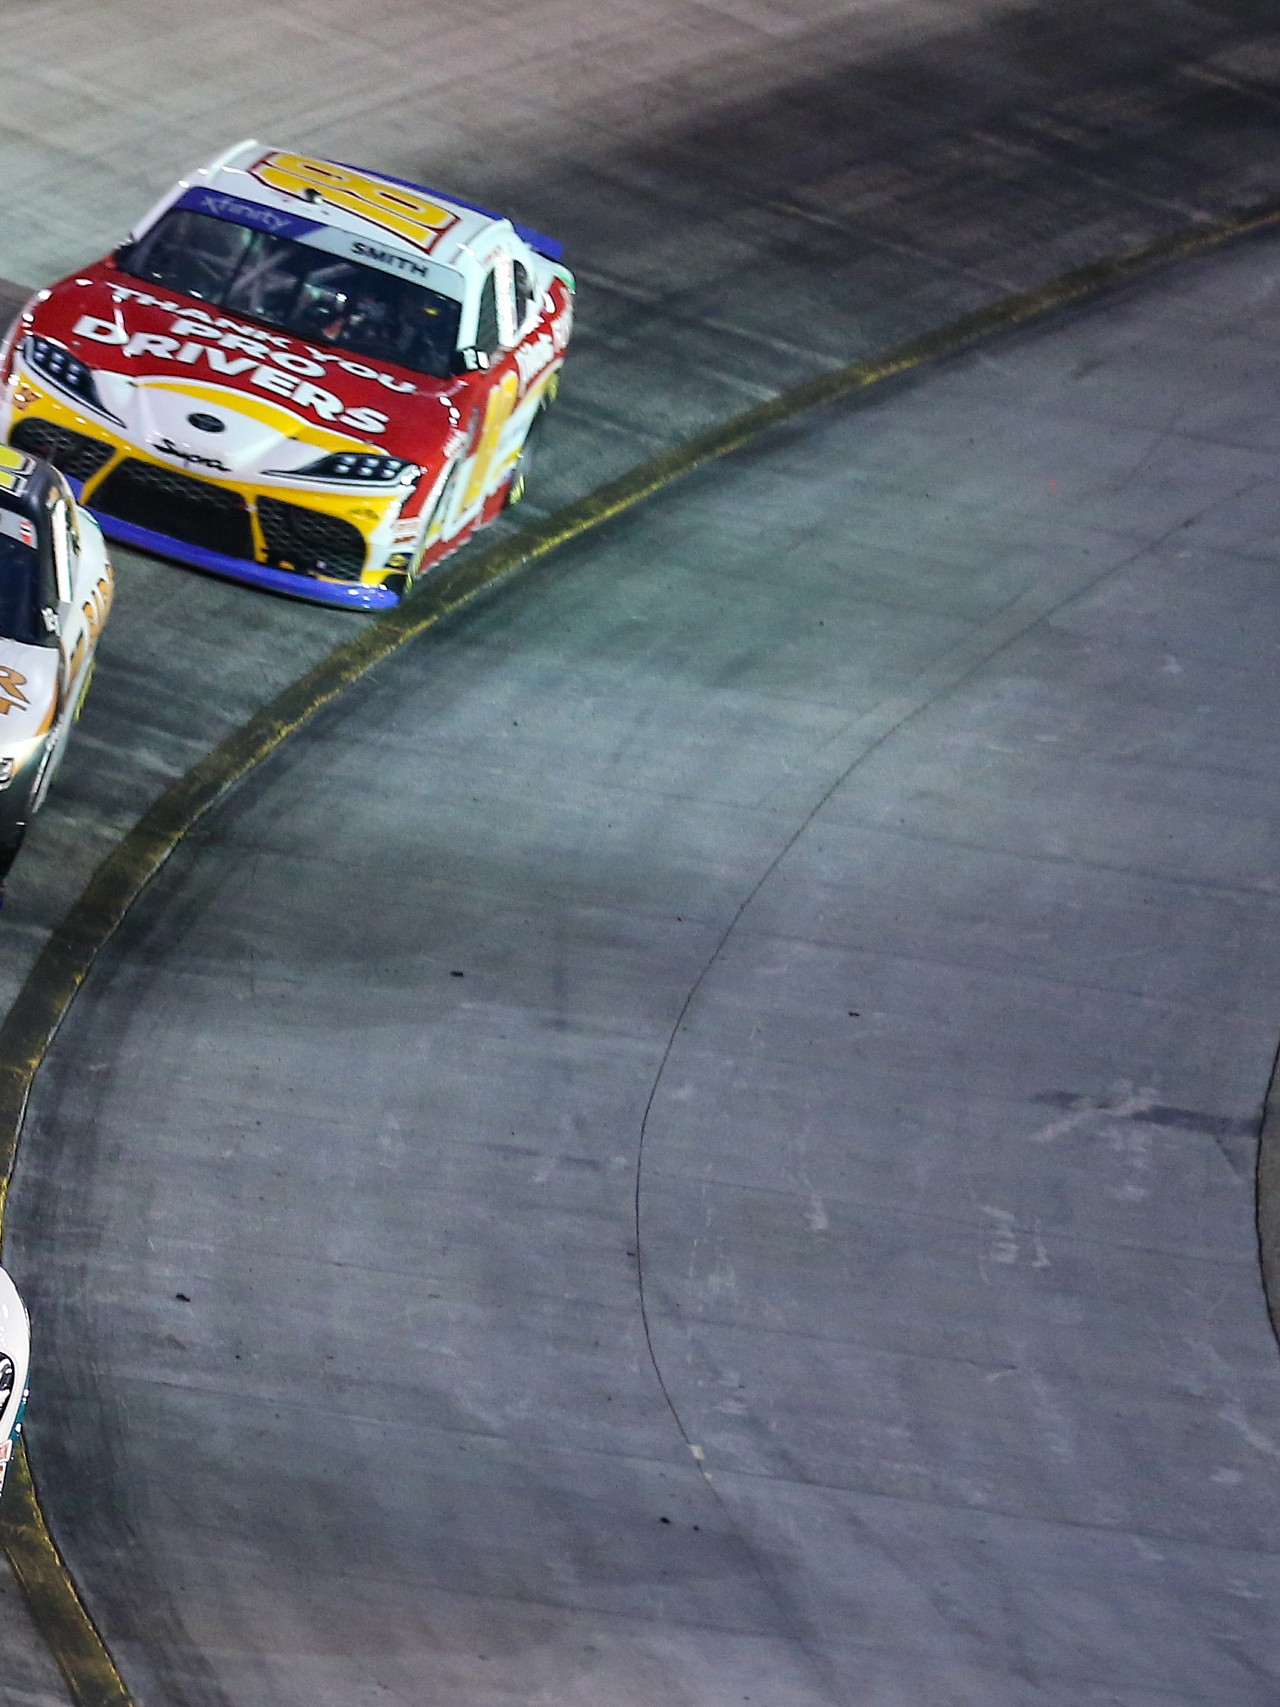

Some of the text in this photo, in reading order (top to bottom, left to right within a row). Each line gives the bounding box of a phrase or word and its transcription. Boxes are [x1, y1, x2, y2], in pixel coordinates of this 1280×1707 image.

[351, 240, 431, 278] SMITH
[106, 281, 418, 394] THANK YOU
[170, 317, 327, 378] PRO
[72, 314, 391, 435] DRIVERS
[153, 438, 233, 472] Supra
